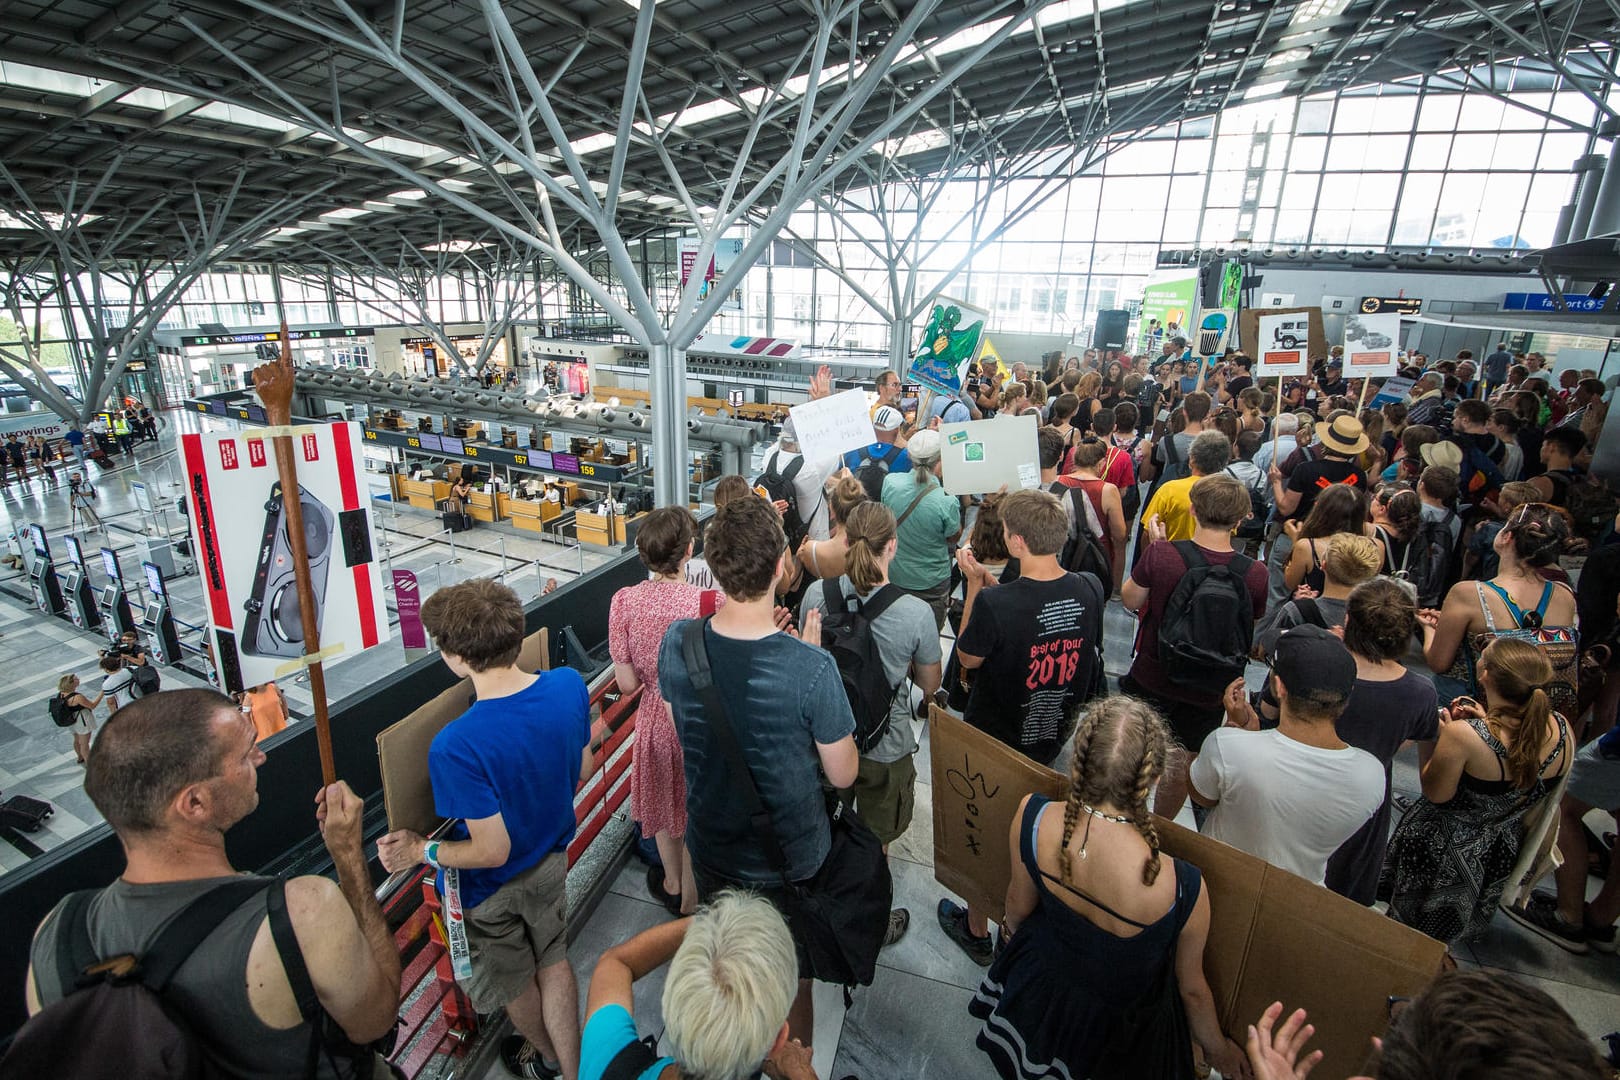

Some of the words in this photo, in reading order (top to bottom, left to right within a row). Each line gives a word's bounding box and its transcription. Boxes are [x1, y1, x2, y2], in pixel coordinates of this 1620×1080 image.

[0, 425, 60, 439] urowings
[366, 431, 377, 440] 154
[408, 438, 419, 447] 155
[465, 447, 477, 456] 156
[514, 455, 527, 464] 157
[581, 465, 595, 476] 158
[1030, 641, 1049, 659] Best
[1050, 639, 1061, 653] of
[1062, 638, 1084, 653] Tour
[1025, 650, 1079, 689] 2018
[452, 943, 461, 960] TEMPO
